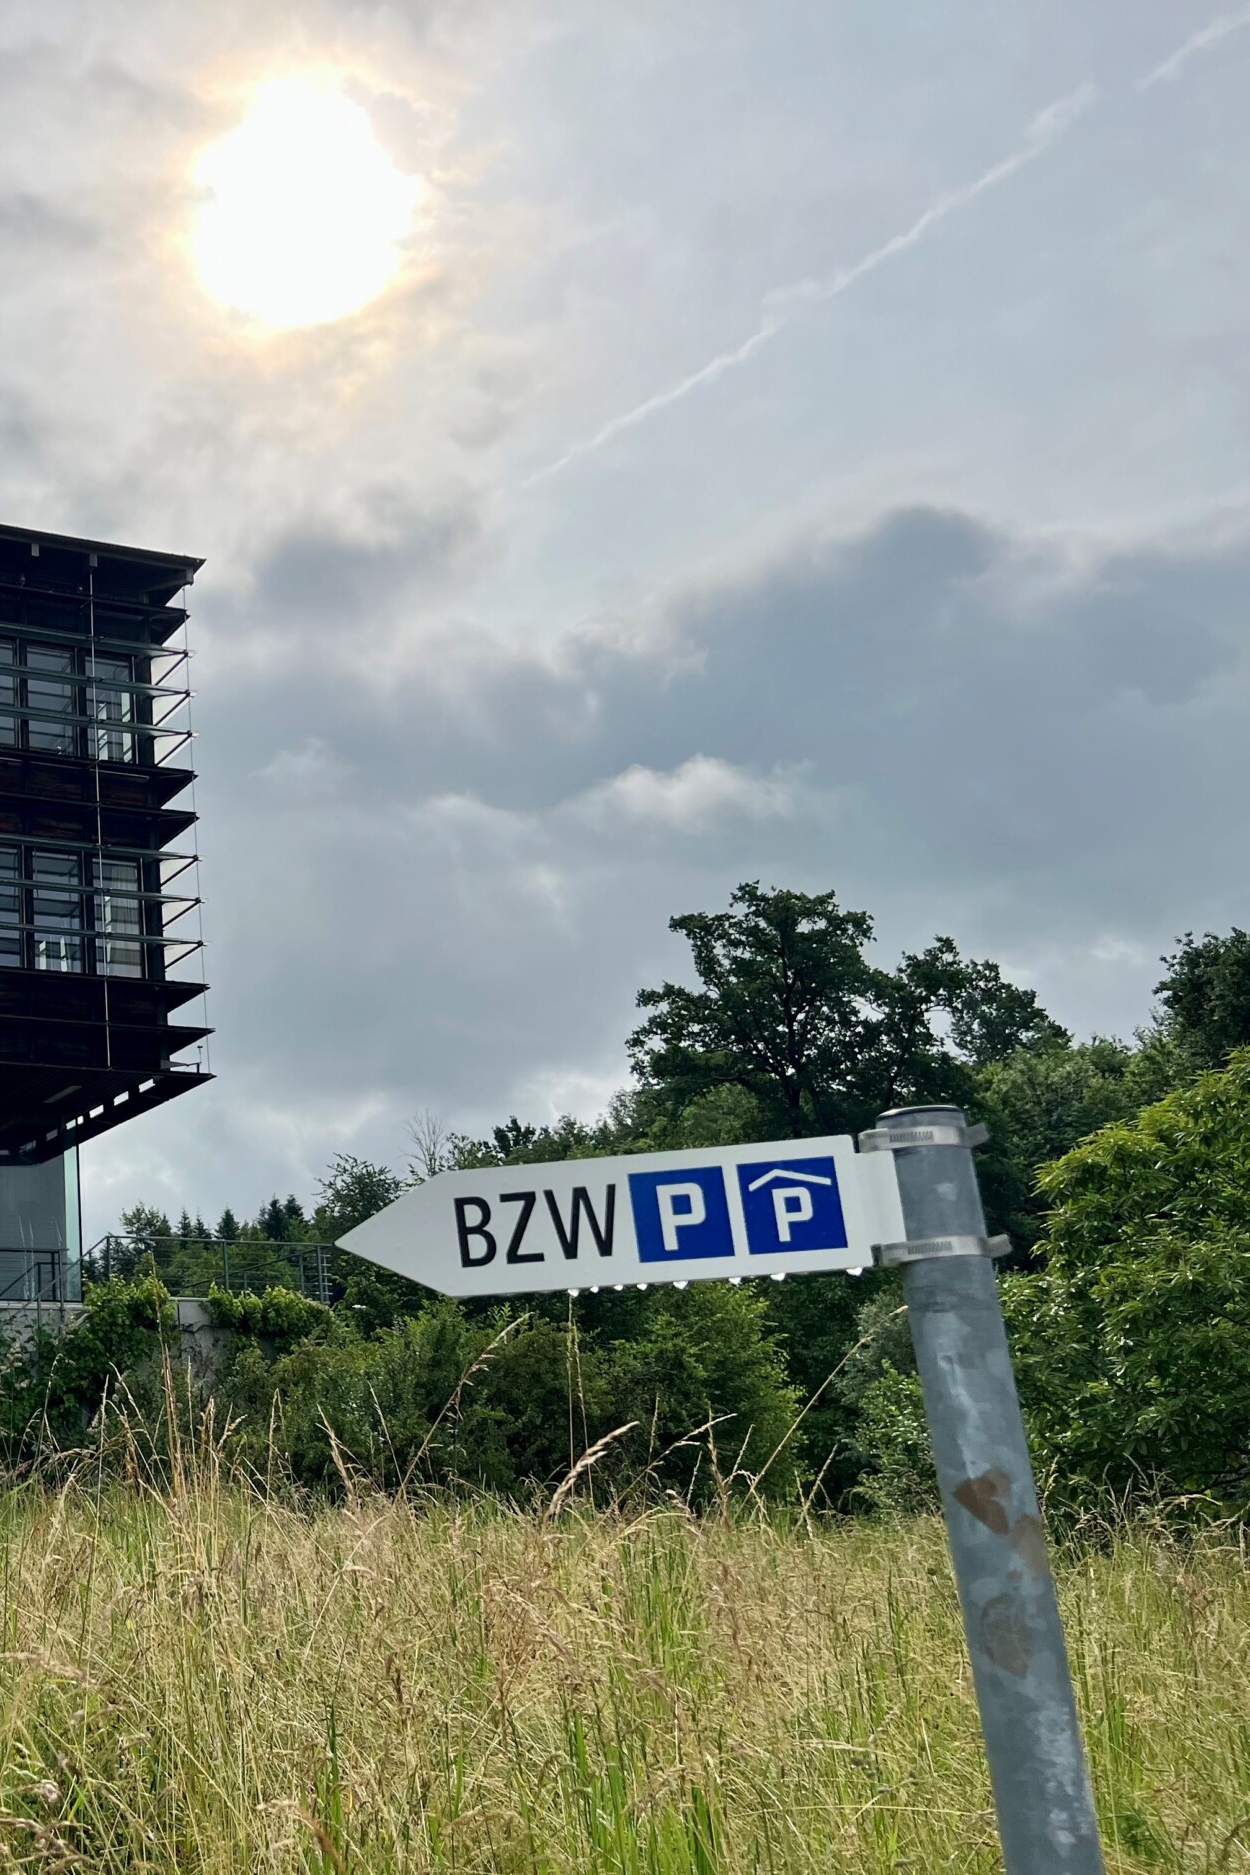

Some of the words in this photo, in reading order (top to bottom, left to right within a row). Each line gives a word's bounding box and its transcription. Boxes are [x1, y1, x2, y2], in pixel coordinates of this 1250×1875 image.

[453, 1183, 616, 1268] BZW
[656, 1182, 707, 1251] P
[772, 1187, 814, 1243] P
